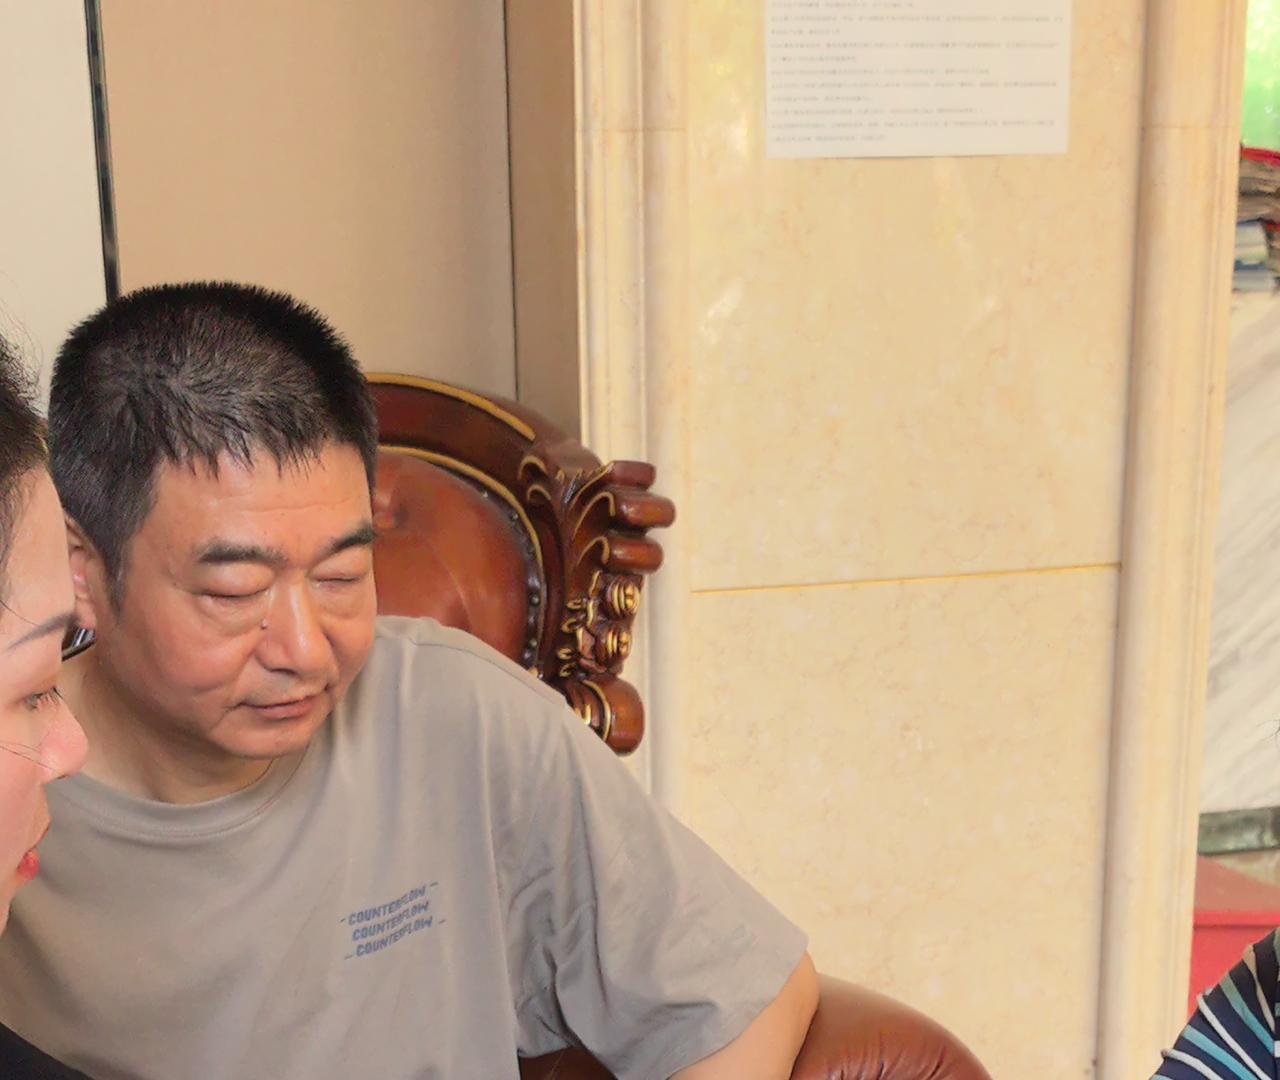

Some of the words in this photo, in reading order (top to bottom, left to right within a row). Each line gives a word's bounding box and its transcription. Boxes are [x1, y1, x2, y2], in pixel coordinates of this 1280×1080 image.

[348, 885, 427, 926] COUNTERFLOW
[352, 901, 430, 942] COUNTERFLOW
[356, 916, 433, 957] COUNTERFLOW
